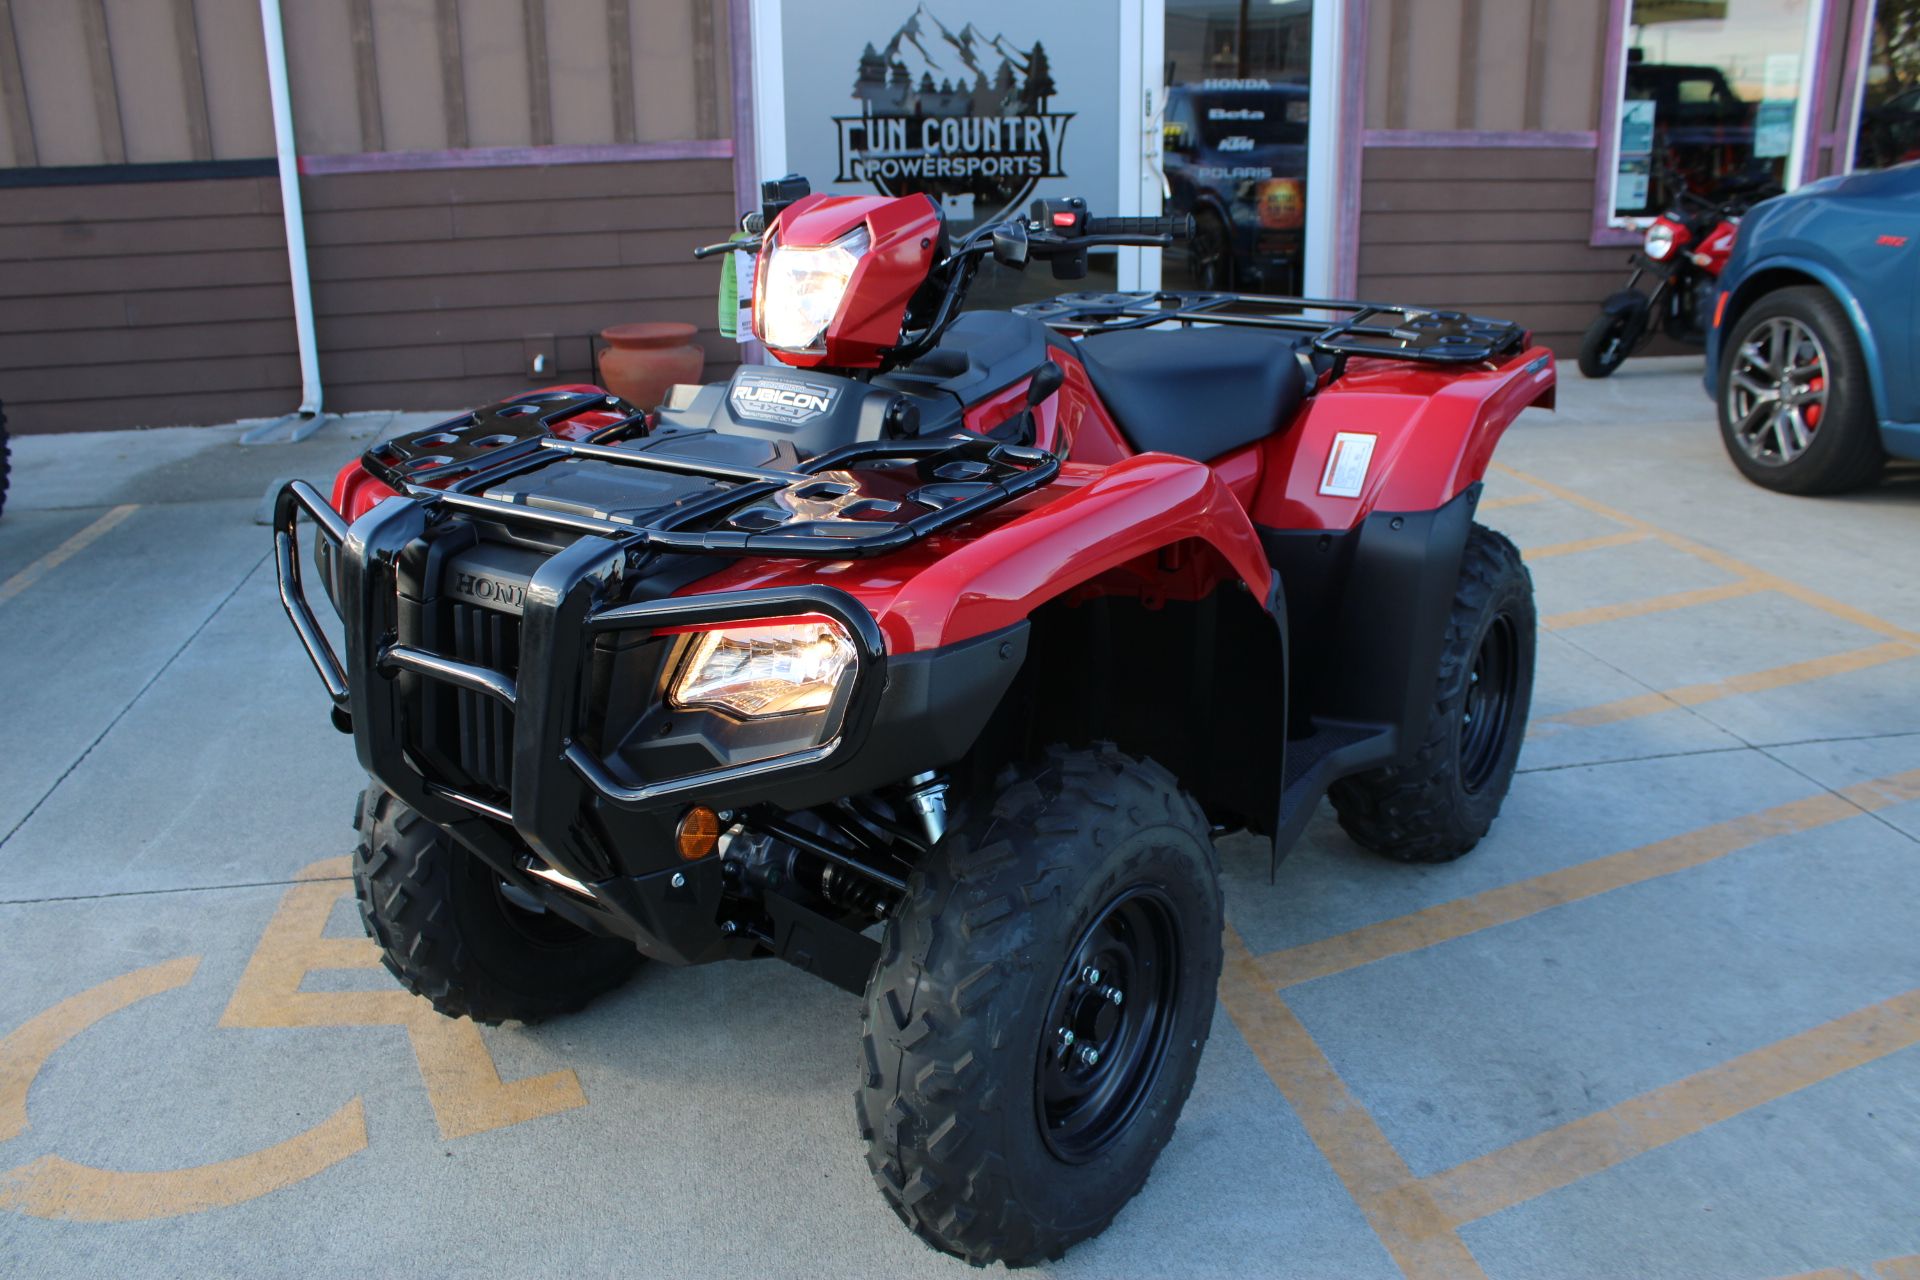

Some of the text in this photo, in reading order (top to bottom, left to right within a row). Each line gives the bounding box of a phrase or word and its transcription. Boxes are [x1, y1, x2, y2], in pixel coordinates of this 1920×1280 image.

[1204, 78, 1271, 91] HONDA
[1208, 108, 1265, 121] Beta
[835, 114, 1075, 183] FUN COUNTRY
[1217, 136, 1255, 151] KTM
[866, 156, 1043, 179] POWERSPORTS
[1199, 167, 1273, 179] POLARIS
[732, 386, 830, 412] RUBICON
[456, 572, 527, 609] HON
